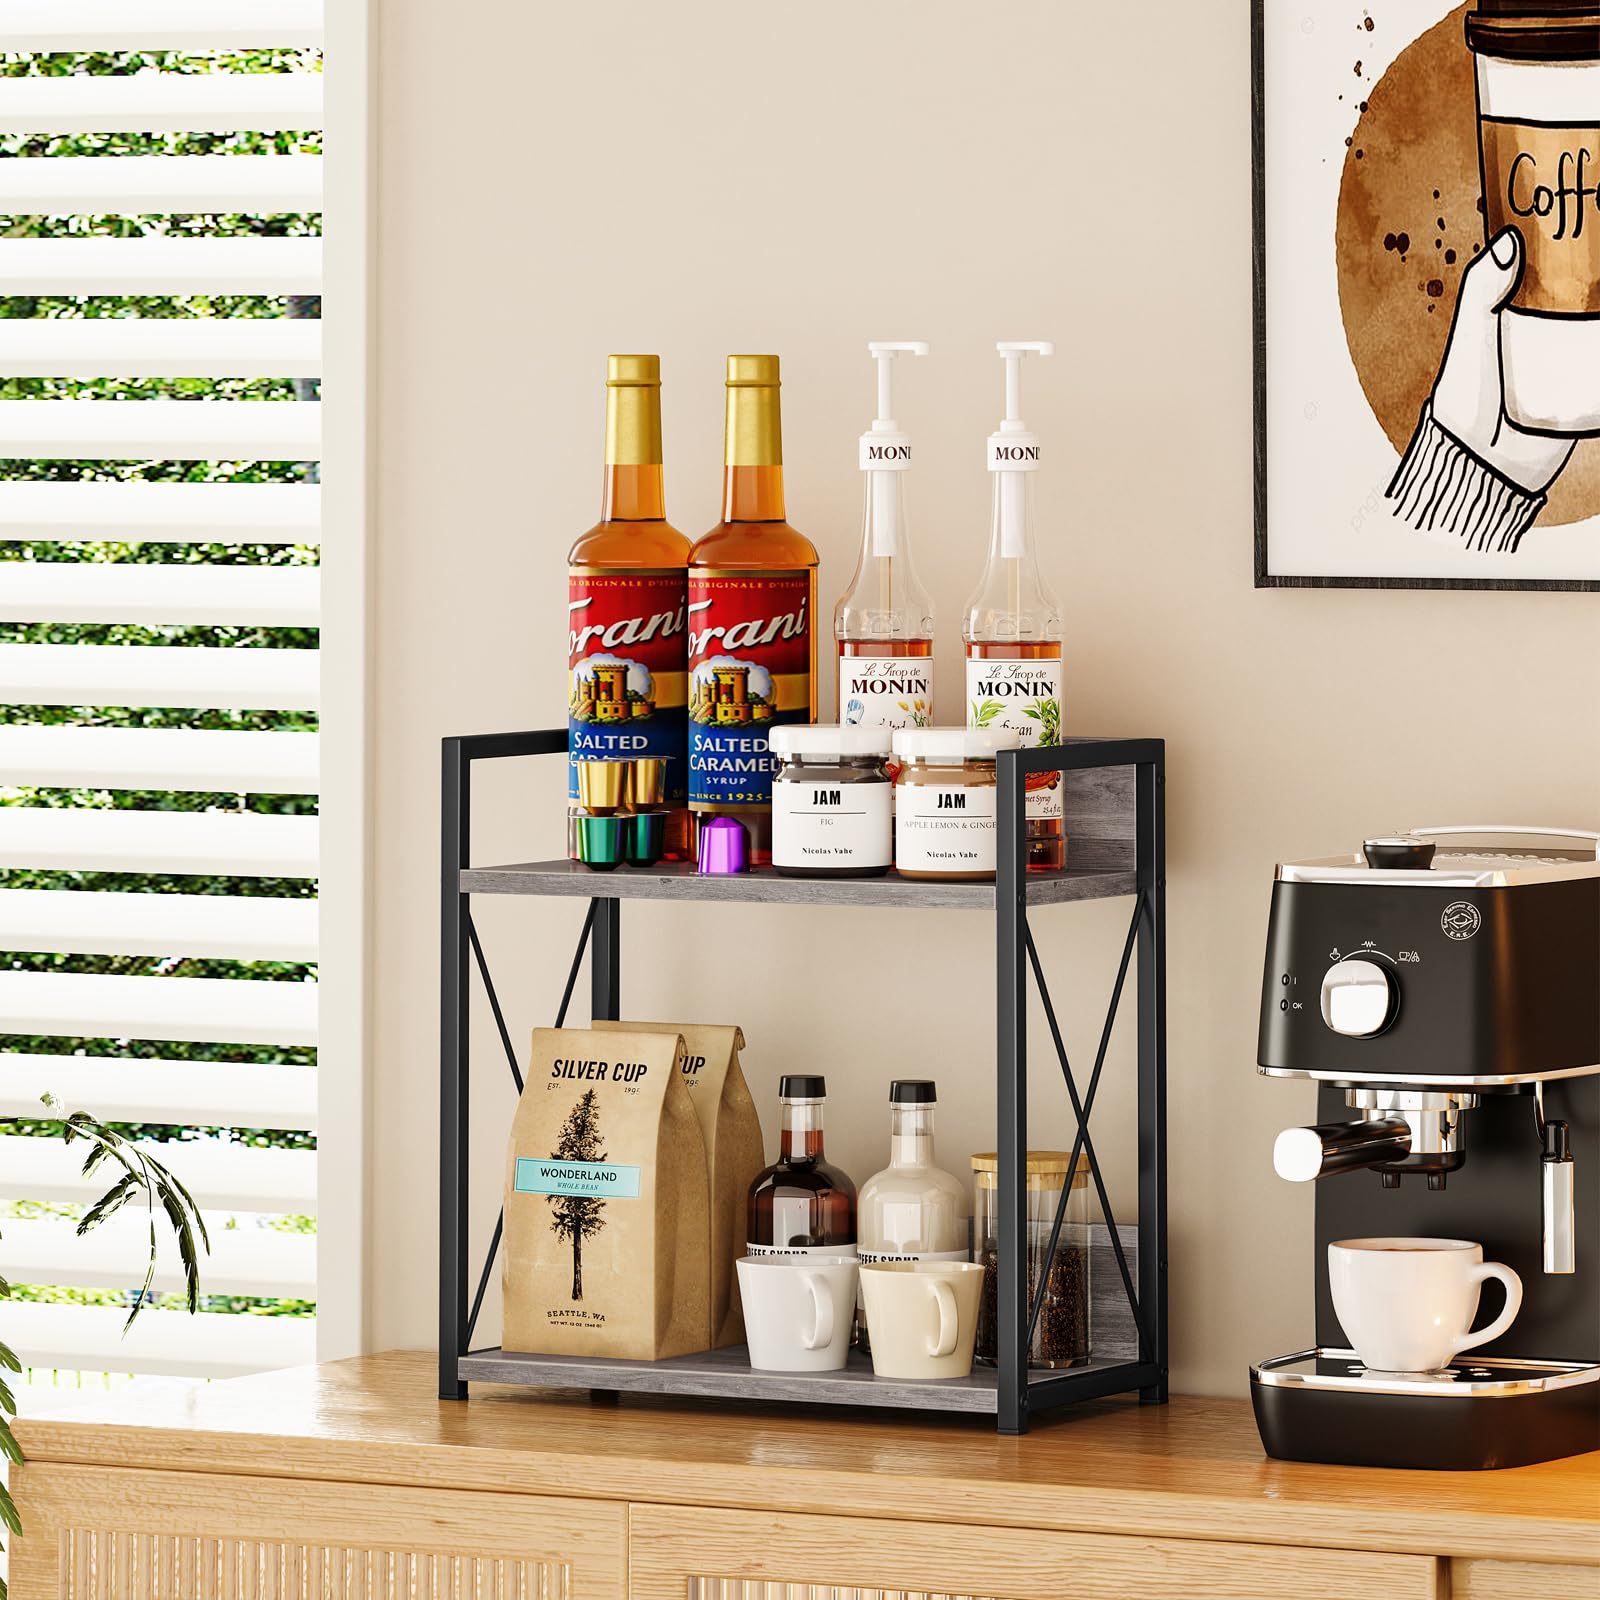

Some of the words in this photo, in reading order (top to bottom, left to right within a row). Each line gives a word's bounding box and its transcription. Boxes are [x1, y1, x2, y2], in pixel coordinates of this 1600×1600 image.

[1507, 147, 1600, 240] Coff
[869, 446, 911, 459] MONI
[859, 662, 877, 677] Le
[879, 662, 908, 679] Sirop
[910, 667, 921, 677] de
[985, 664, 1002, 679] Le
[1004, 664, 1034, 682] Sirop
[1035, 669, 1047, 679] de
[851, 679, 928, 694] MONIN
[977, 681, 1054, 697] MONIN
[574, 731, 649, 750] SALTED
[694, 734, 769, 753] SALTED
[690, 753, 778, 772] CARAMEL
[705, 776, 748, 785] SYRUP
[727, 792, 763, 801] 1925
[812, 790, 841, 806] JAM
[937, 793, 966, 809] JAM
[820, 818, 834, 826] FIG
[904, 821, 929, 829] APPLE
[930, 821, 959, 829] LEMON
[969, 821, 997, 829] GINGE
[802, 847, 831, 855] Nicolas
[834, 847, 853, 855] Vahe
[1292, 1002, 1303, 1010] OK
[551, 1058, 609, 1081] SILVER
[612, 1062, 648, 1083] CUP
[680, 1055, 706, 1074] UP
[540, 1167, 617, 1182] WONDERLAND
[556, 1182, 580, 1190] WHOLE
[580, 1183, 599, 1191] BEAN
[592, 1312, 606, 1322] WA
